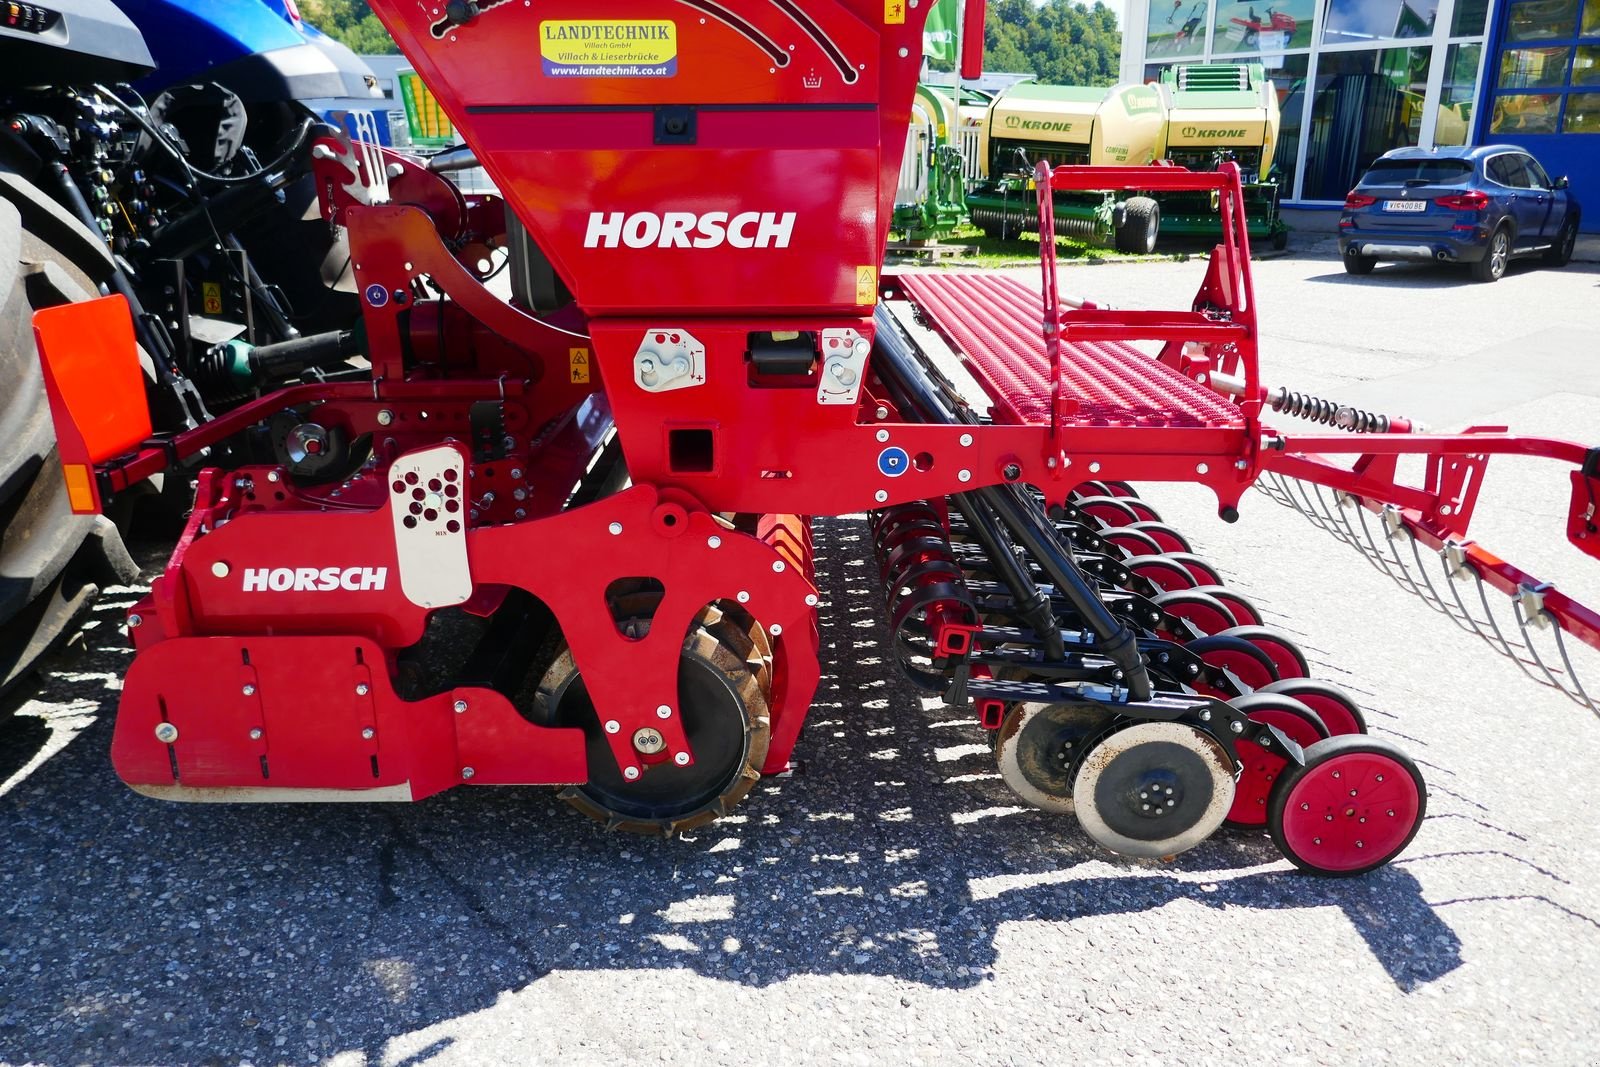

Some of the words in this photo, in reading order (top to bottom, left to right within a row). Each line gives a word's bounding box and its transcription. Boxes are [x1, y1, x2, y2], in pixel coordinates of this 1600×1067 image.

[545, 25, 670, 40] LANDTECHNIK
[558, 52, 589, 61] Villach
[591, 53, 598, 61] &
[600, 52, 659, 61] Lieserbrücke
[551, 65, 667, 76] www.landtechnik.co.at
[1021, 120, 1073, 132] KRONE
[1196, 129, 1247, 138] KRONE
[583, 211, 797, 249] HORSCH
[242, 566, 388, 592] HORSCH
